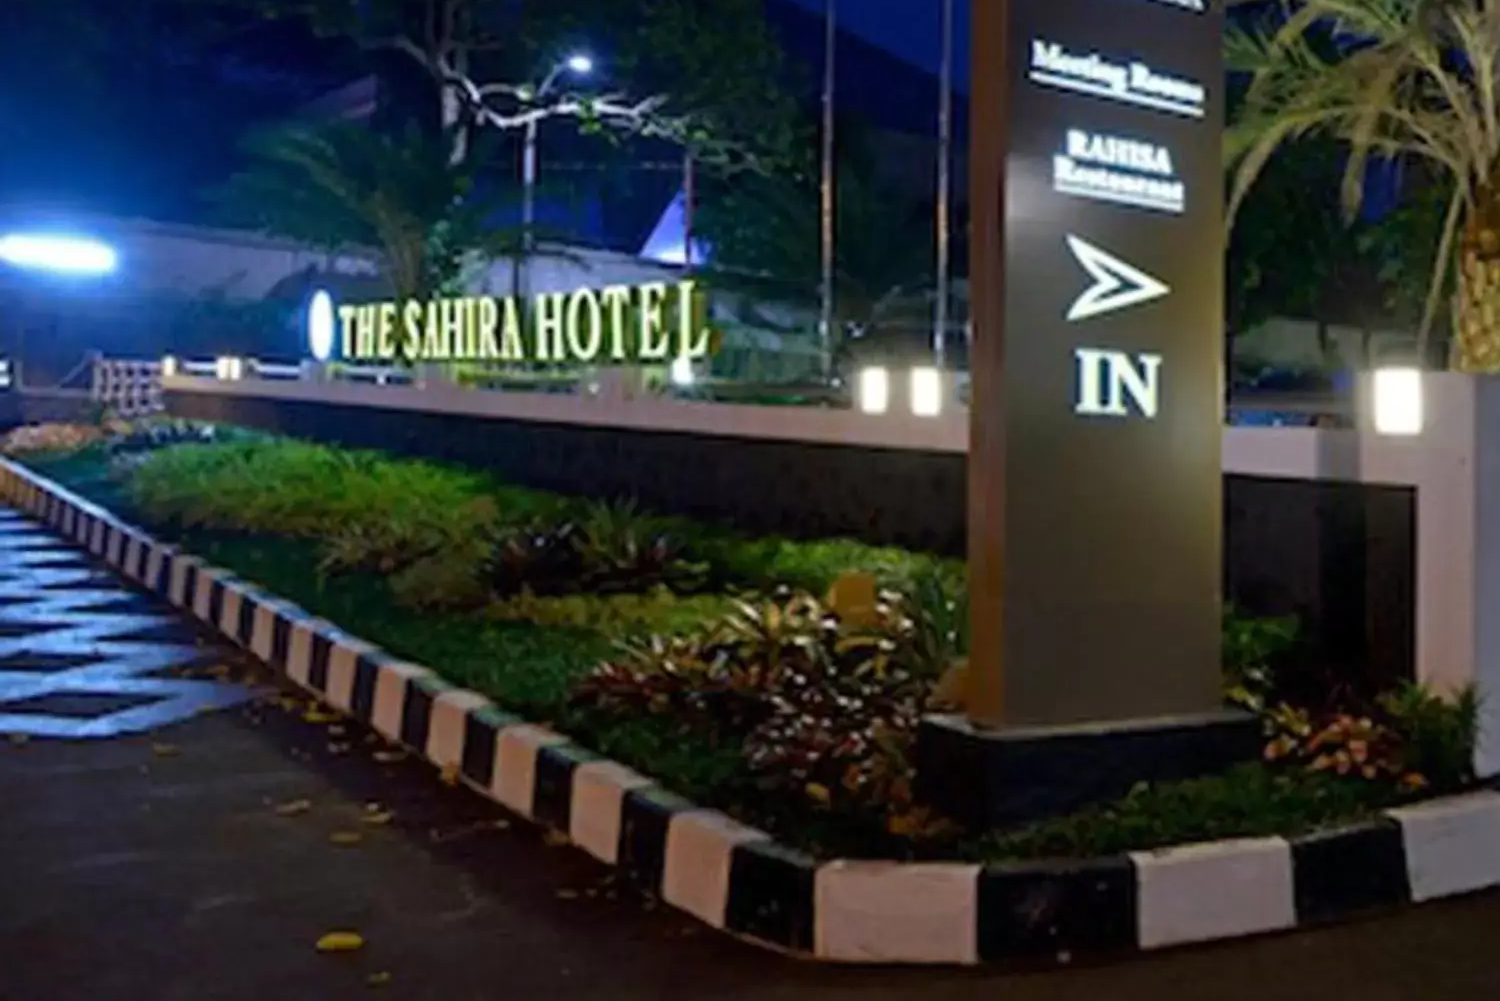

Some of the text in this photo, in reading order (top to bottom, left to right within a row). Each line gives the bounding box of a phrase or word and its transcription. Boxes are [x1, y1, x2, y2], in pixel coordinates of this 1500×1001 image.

[338, 280, 711, 361] THE SAHIRA HOTEL
[1074, 349, 1163, 418] IN
